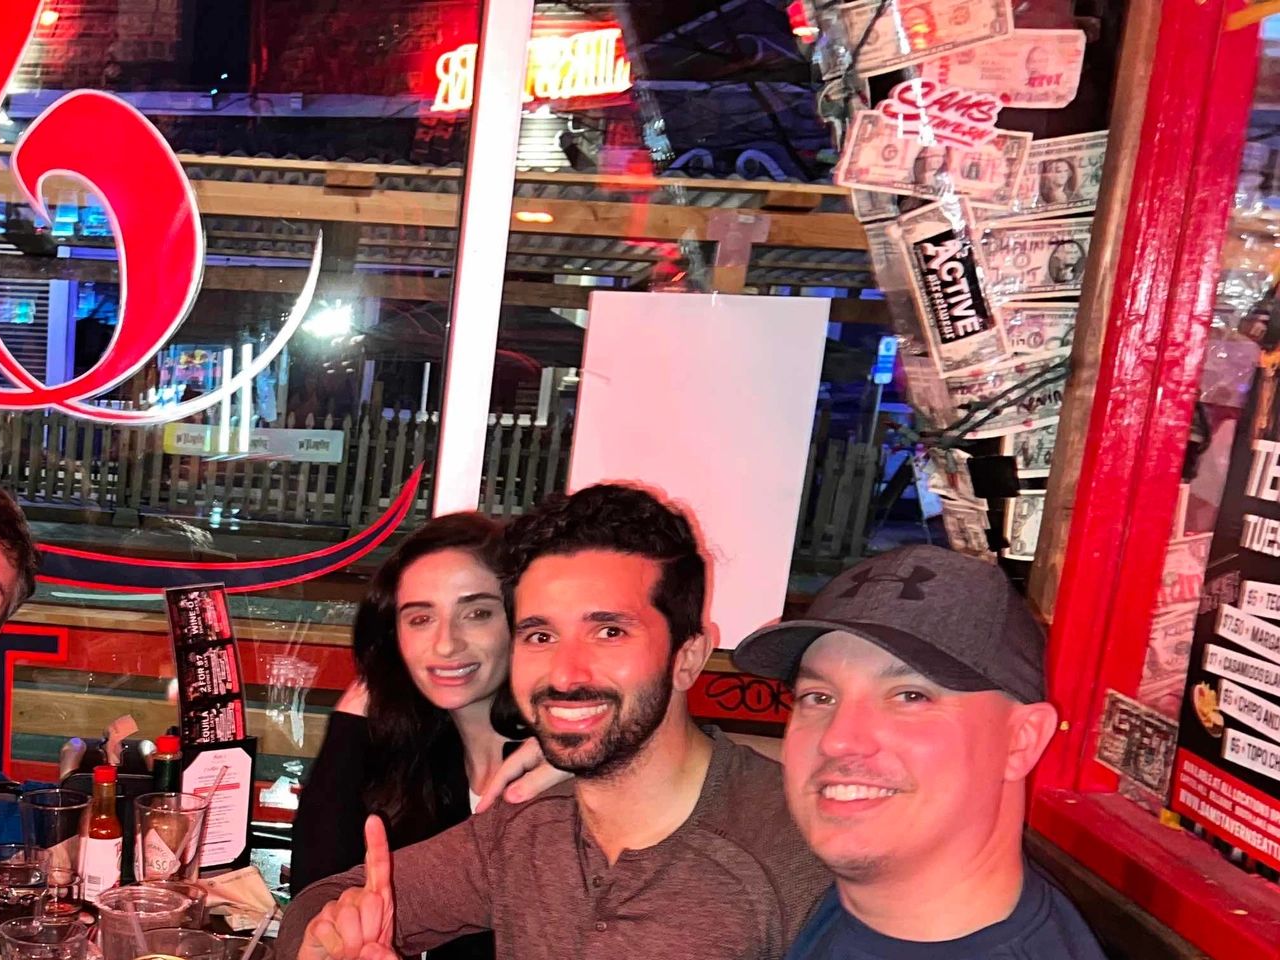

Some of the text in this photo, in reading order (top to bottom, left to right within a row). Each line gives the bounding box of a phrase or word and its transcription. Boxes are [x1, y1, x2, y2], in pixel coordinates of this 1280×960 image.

[922, 238, 982, 338] ACTIVE
[201, 711, 210, 743] EQUILA
[1246, 742, 1268, 766] TOPO
